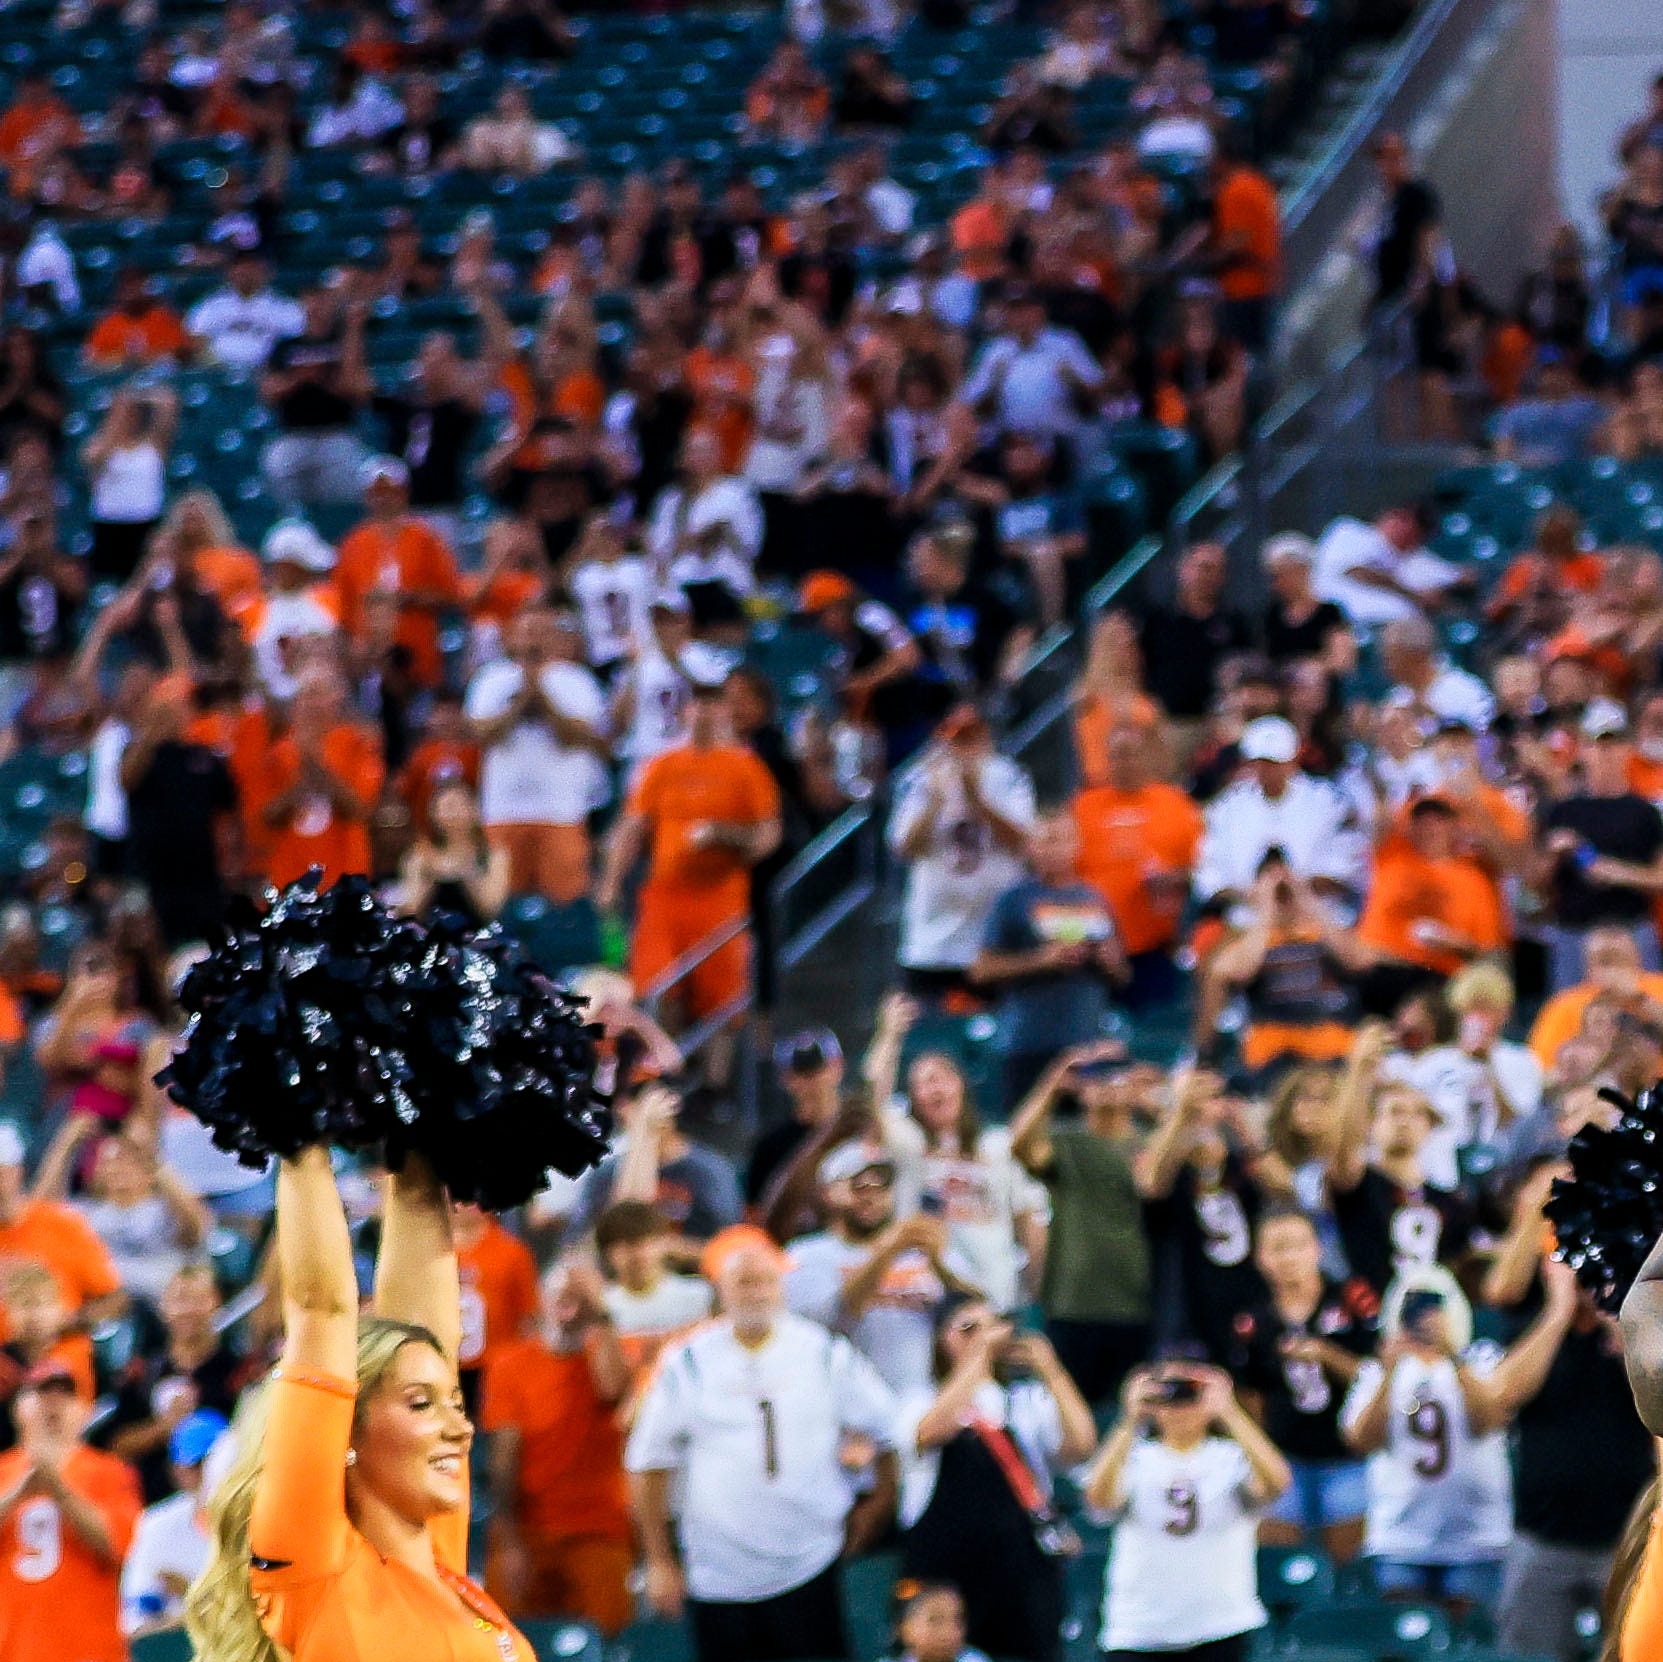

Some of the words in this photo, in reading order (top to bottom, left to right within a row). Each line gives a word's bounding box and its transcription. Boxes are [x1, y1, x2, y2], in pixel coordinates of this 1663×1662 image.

[755, 1399, 780, 1480] 1
[1408, 1401, 1447, 1478] 9
[12, 1498, 62, 1582] 9
[1165, 1480, 1196, 1535] 9
